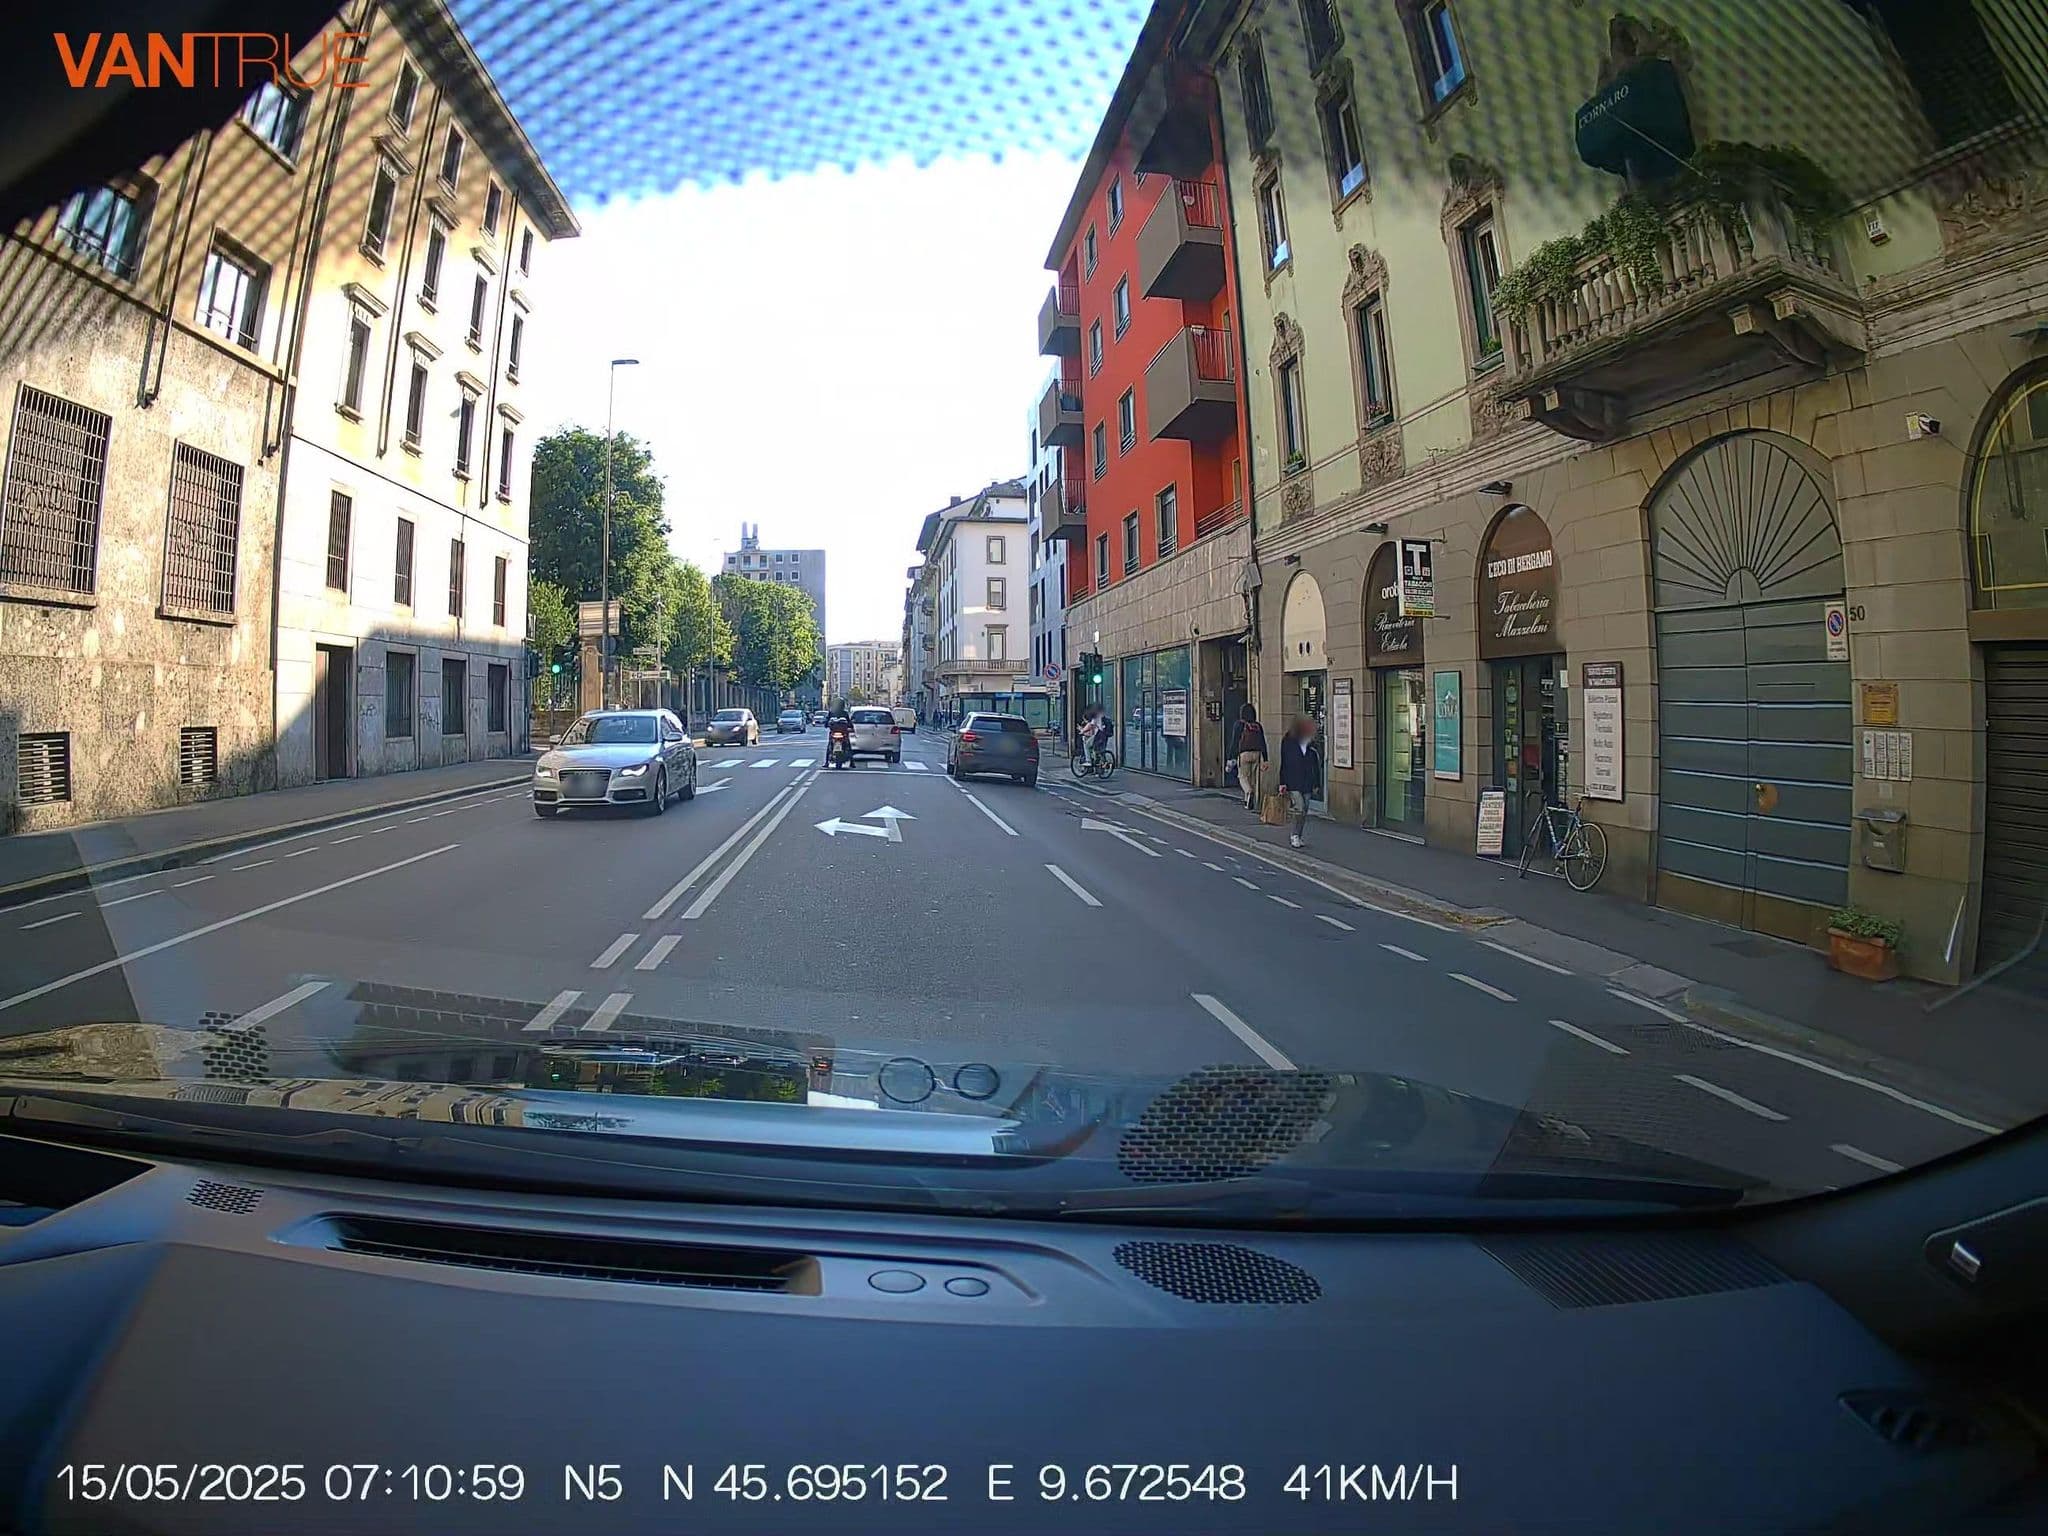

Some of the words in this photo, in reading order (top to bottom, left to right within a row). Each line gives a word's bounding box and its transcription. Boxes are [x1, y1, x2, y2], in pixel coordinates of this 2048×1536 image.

[1578, 85, 1630, 129] CORNARO
[1405, 544, 1427, 576] T
[1487, 560, 1507, 578] L'ECO
[1507, 558, 1516, 575] DI
[1516, 549, 1553, 573] BERGAMO
[1493, 590, 1551, 615] Tabaccheria
[1849, 605, 1865, 621] 50
[1495, 614, 1551, 638] Mazzoleni
